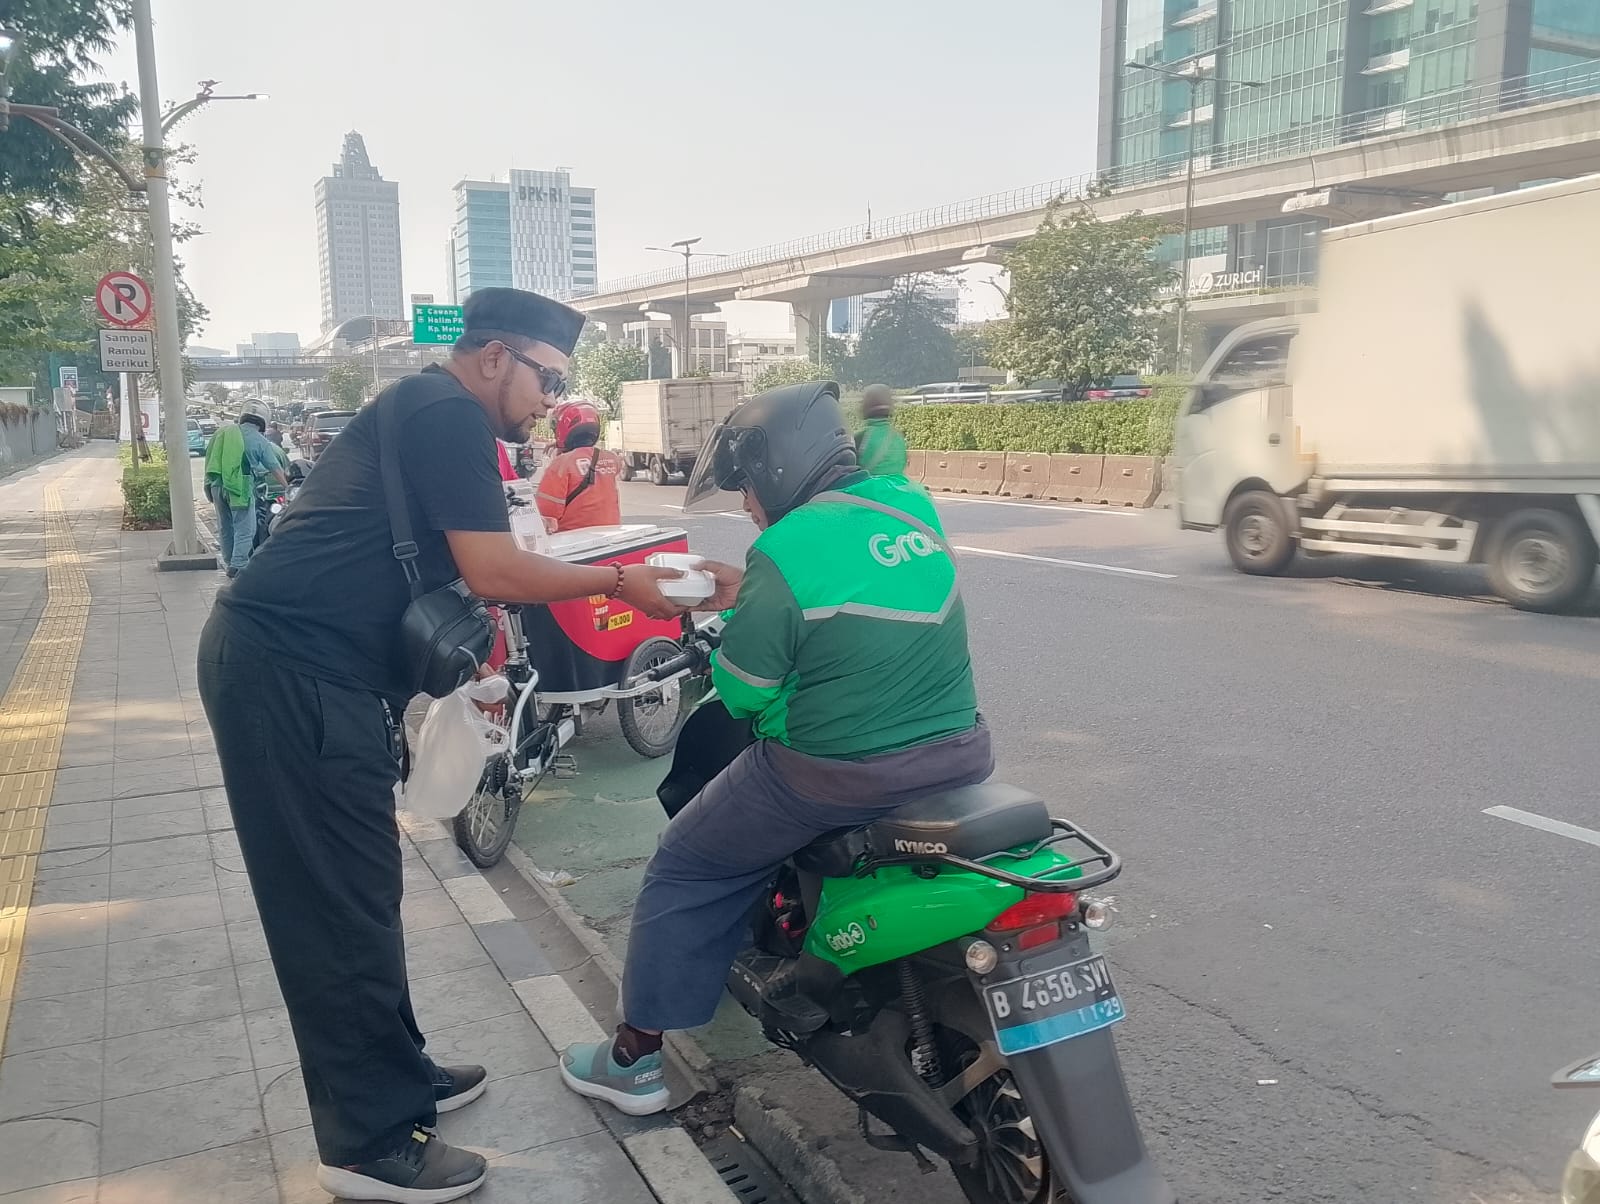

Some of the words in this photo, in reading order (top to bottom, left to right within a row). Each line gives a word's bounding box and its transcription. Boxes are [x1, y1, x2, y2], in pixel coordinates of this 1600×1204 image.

[519, 186, 563, 202] BPK-RI
[1214, 270, 1261, 288] ZURICH
[427, 308, 458, 317] Cawang
[441, 325, 465, 334] Melay
[105, 334, 148, 344] Sampai
[107, 346, 146, 356] Rambu
[106, 359, 149, 368] Berikut
[894, 838, 948, 854] KYMCO
[825, 928, 856, 951] Grab
[991, 991, 1011, 1018] B
